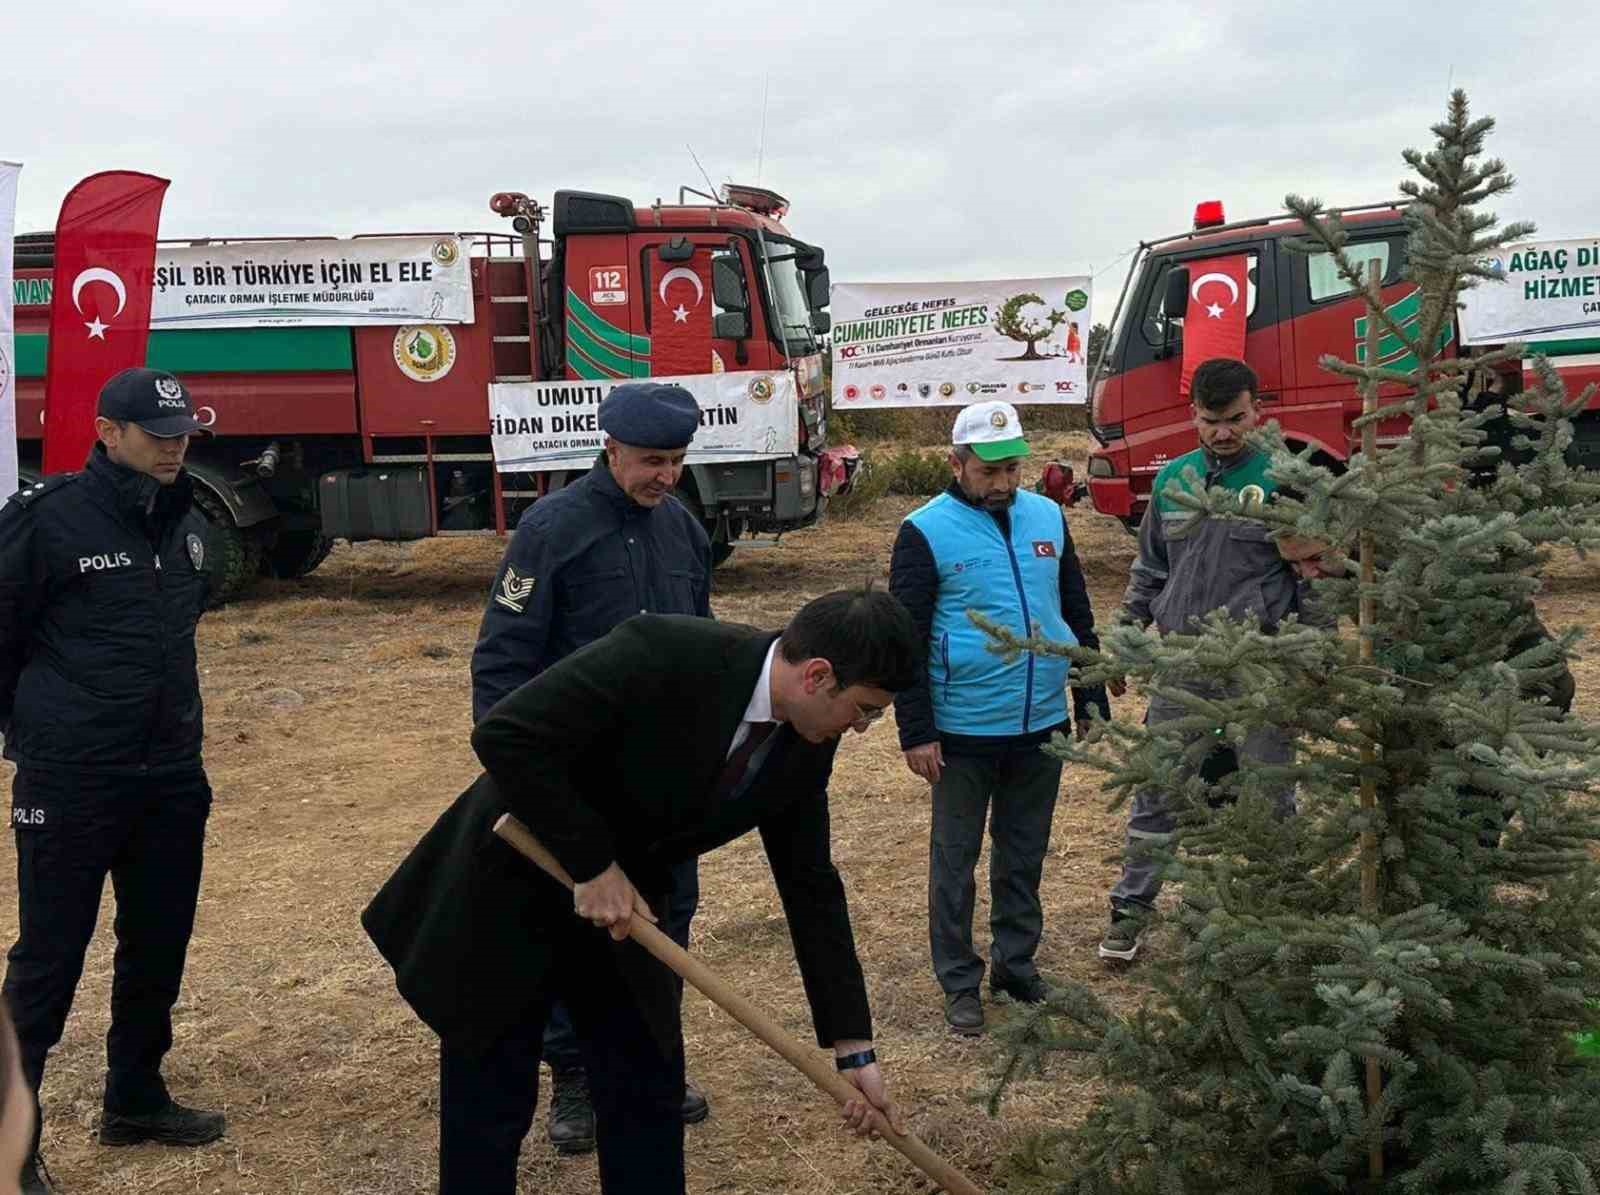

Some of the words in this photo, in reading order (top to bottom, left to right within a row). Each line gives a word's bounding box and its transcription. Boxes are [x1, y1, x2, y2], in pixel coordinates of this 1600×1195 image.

[1509, 247, 1568, 273] AĞAÇ
[1577, 241, 1600, 266] Dİ
[193, 261, 225, 286] BİR
[232, 260, 315, 286] TÜRKİYE
[321, 259, 362, 289] İÇİN
[370, 263, 392, 283] EL
[400, 261, 433, 282] ELE
[595, 271, 621, 288] 112
[13, 279, 53, 305] MAN
[185, 294, 227, 306] ÇATACIK
[230, 294, 265, 304] ORMAN
[268, 292, 310, 305] İŞLETME
[864, 301, 919, 318] GELECEĞE
[922, 298, 956, 310] NEFES
[941, 305, 988, 329] NEFES
[537, 386, 610, 407] UMUTL
[551, 410, 602, 433] DİKE
[570, 437, 601, 449] ORMAN
[79, 552, 132, 573] POLİS
